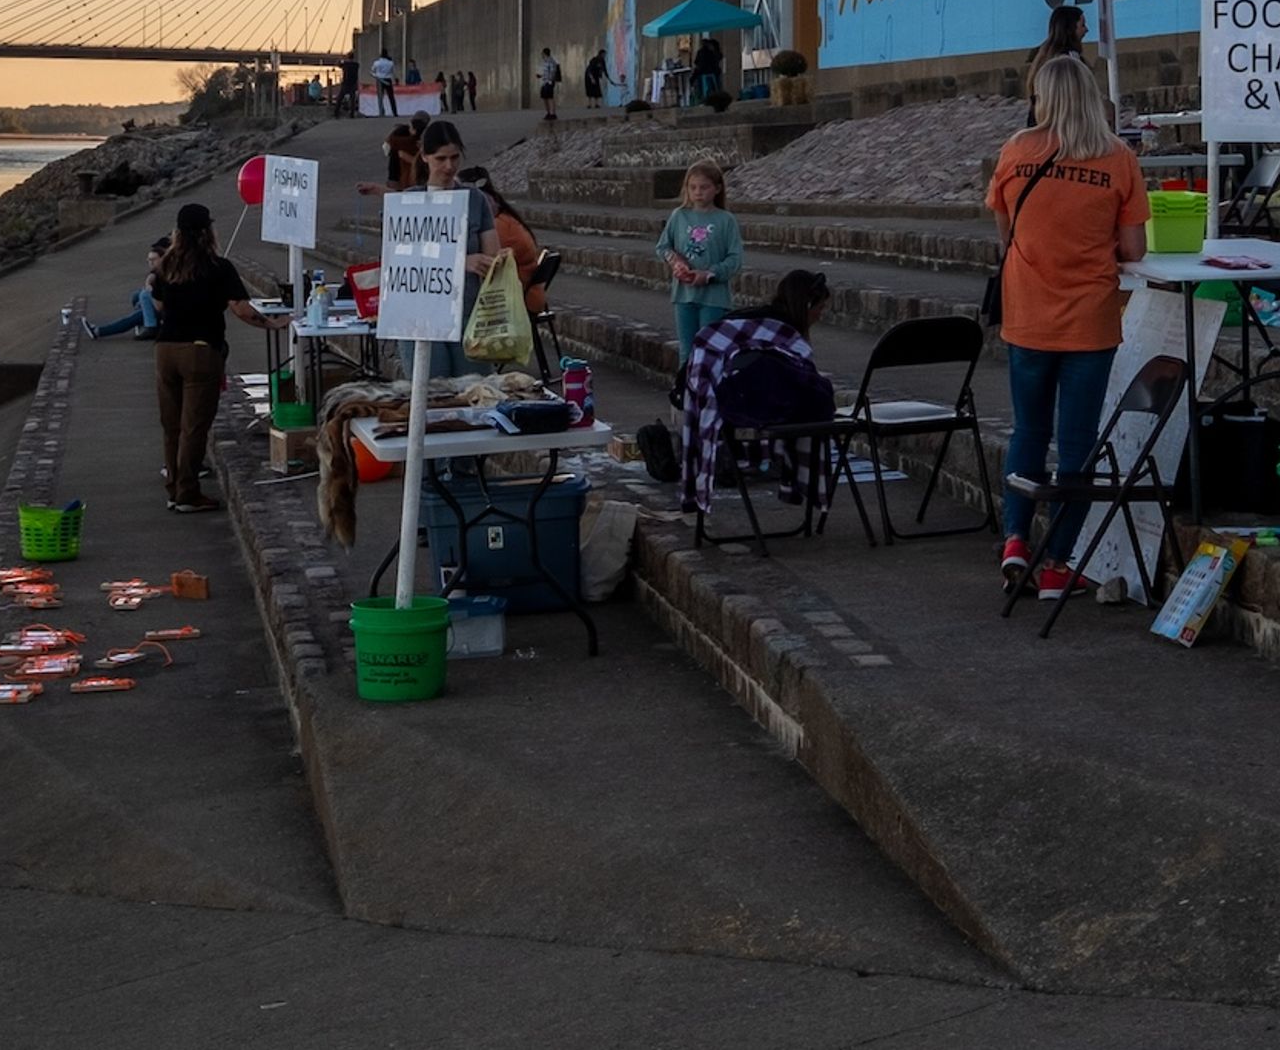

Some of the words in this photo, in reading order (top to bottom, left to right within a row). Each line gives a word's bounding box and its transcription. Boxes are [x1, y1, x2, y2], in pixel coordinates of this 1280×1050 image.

[274, 168, 308, 190] FISHING
[279, 200, 298, 218] FUN
[389, 215, 458, 243] MAMMAL
[387, 266, 453, 295] MADNESS
